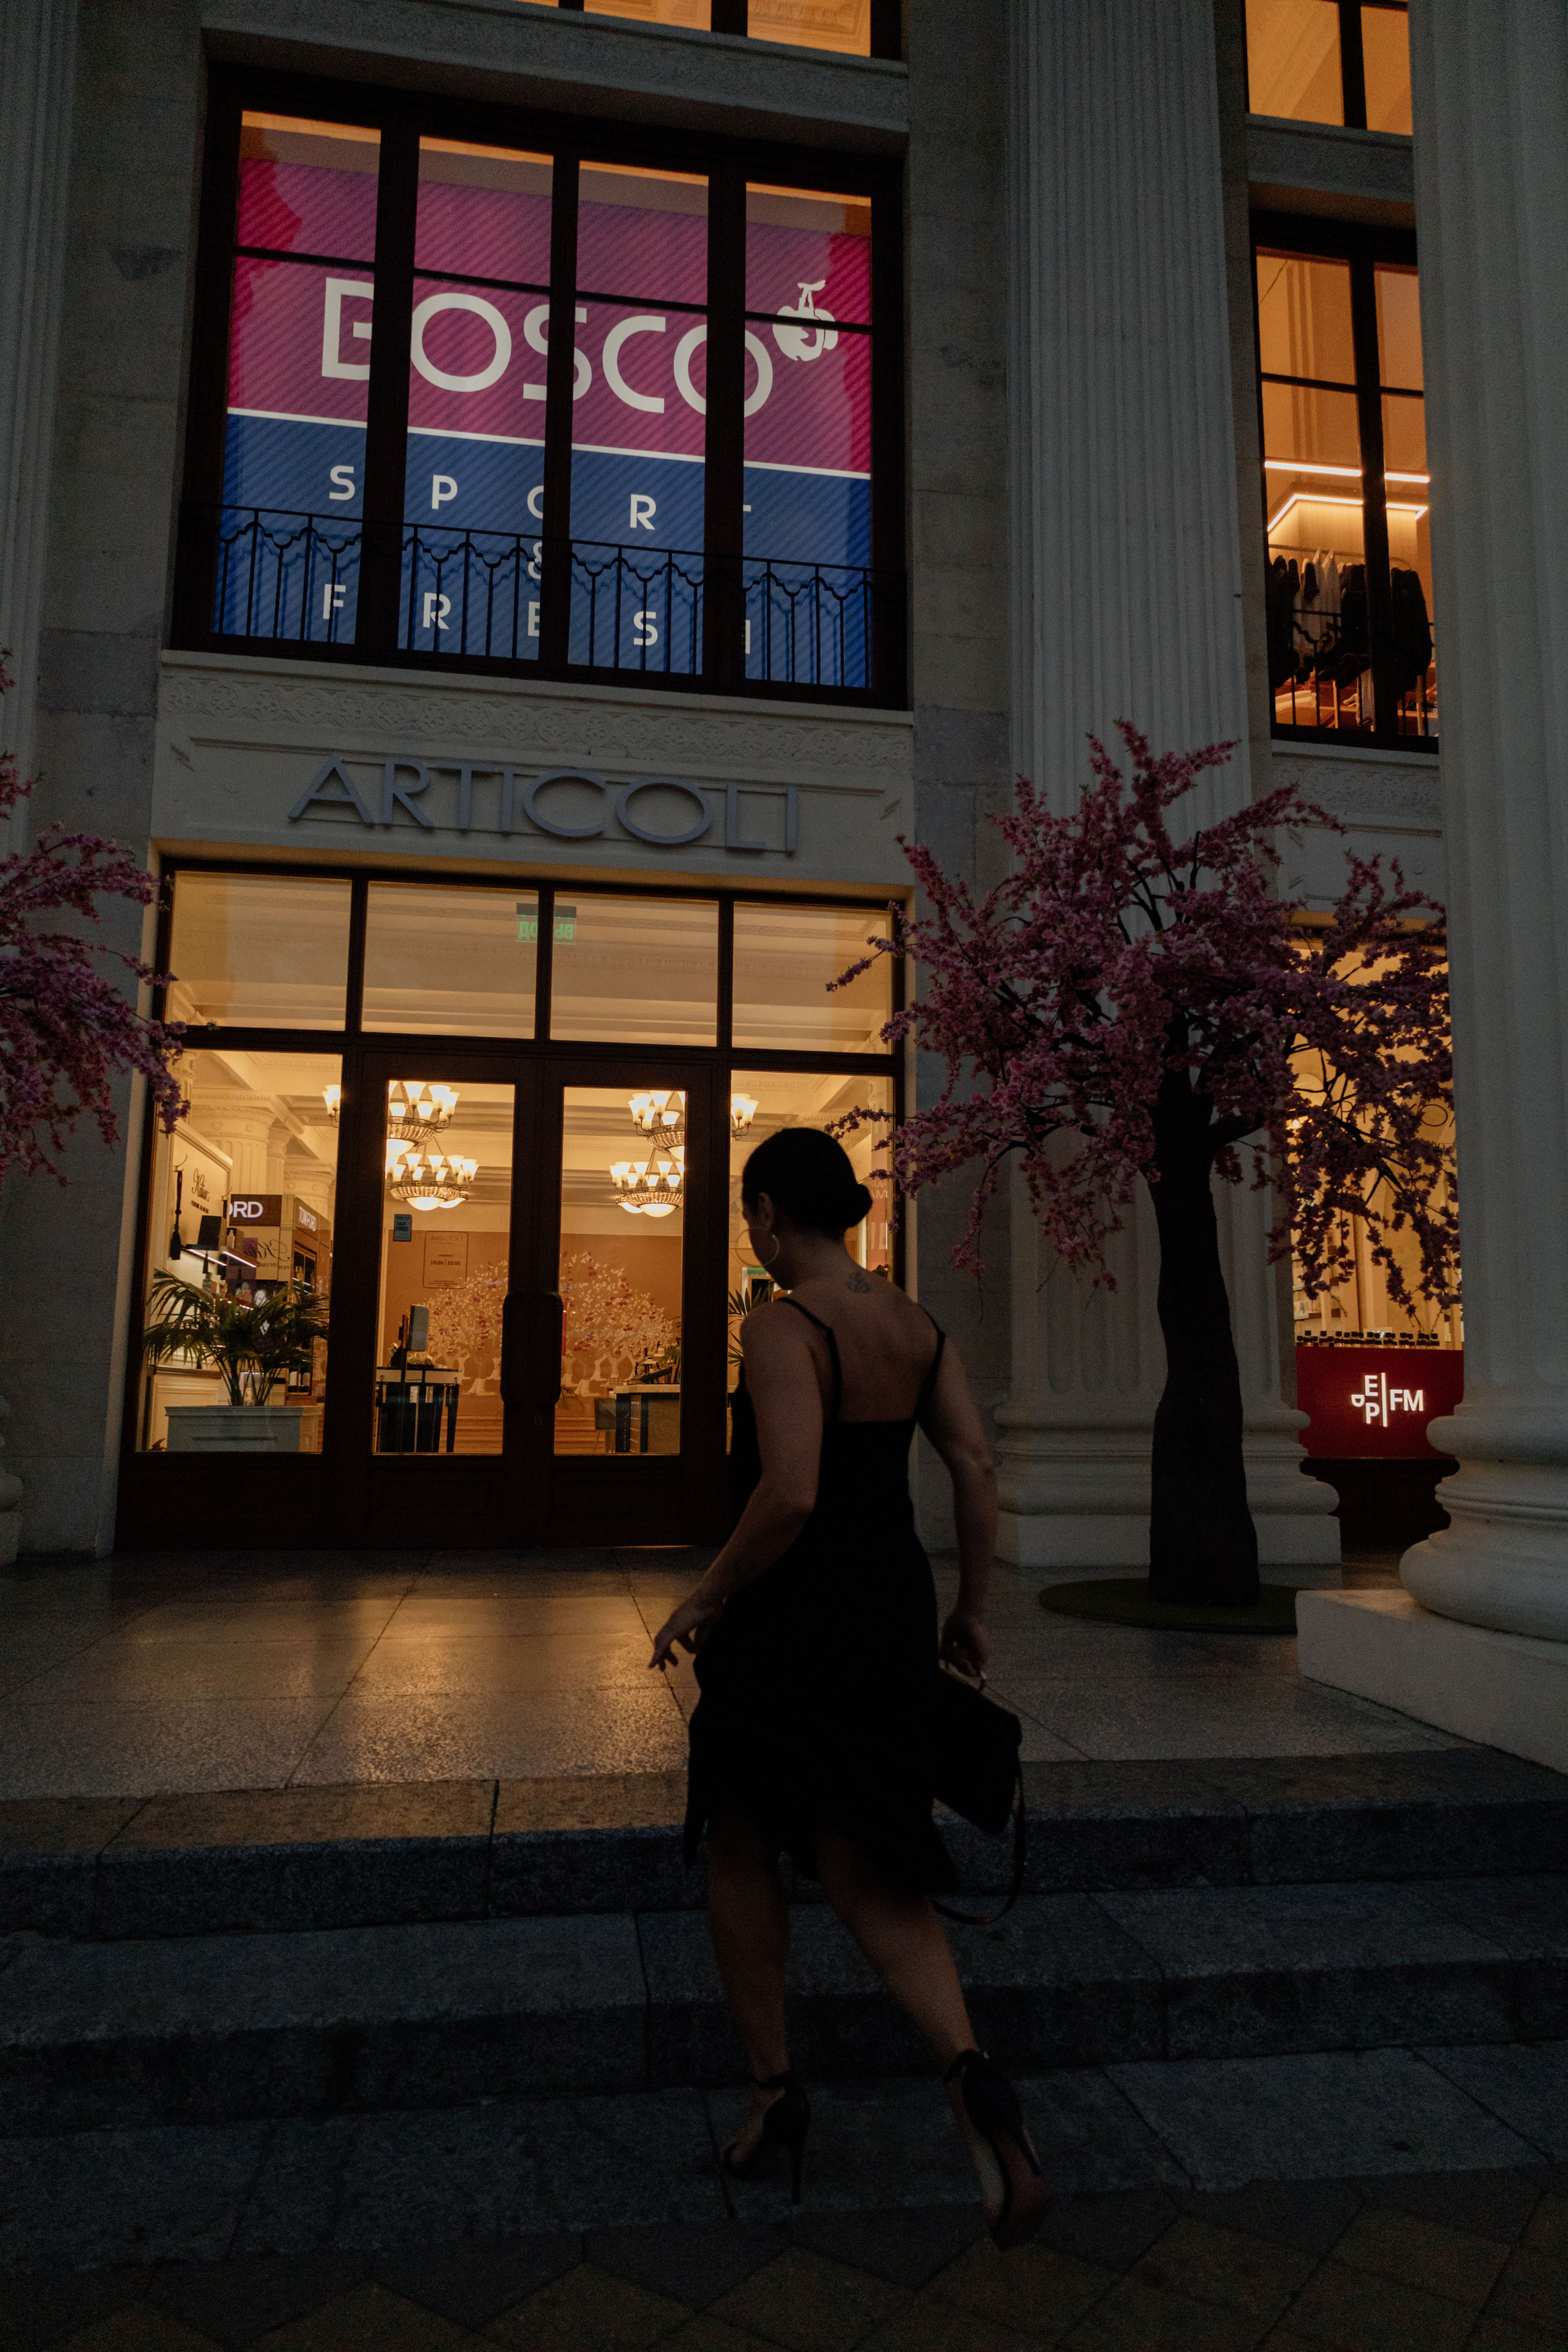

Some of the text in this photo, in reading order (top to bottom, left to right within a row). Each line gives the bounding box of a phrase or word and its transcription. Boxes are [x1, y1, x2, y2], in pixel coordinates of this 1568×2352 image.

[321, 277, 774, 418] BOSCO
[287, 753, 797, 854] ARTICOLI
[1389, 1389, 1423, 1412] FM
